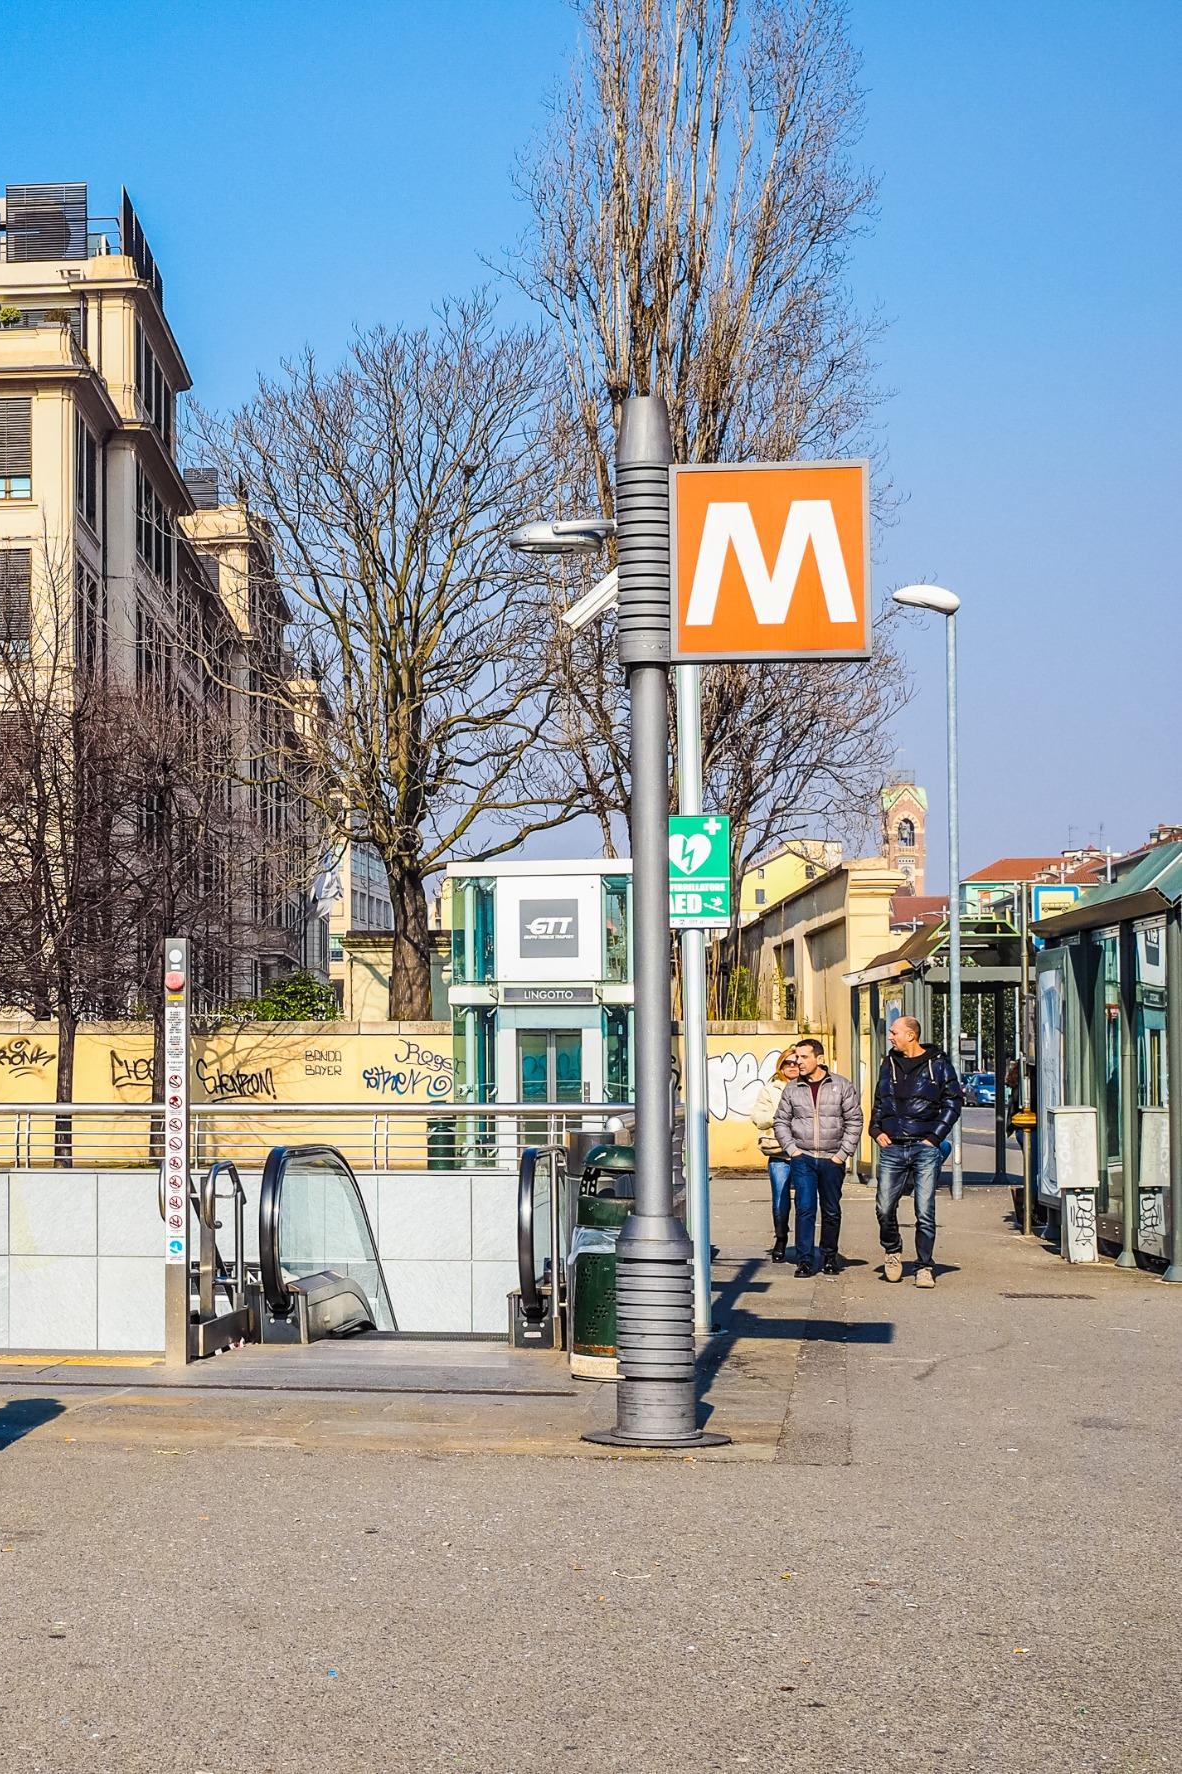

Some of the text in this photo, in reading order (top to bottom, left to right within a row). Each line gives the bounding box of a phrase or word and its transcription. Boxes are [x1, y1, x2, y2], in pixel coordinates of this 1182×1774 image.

[685, 499, 858, 626] M
[526, 916, 574, 935] GTT
[523, 989, 574, 1000] LINGOTTO
[304, 1050, 342, 1063] BANDA
[304, 1064, 342, 1077] BAYER
